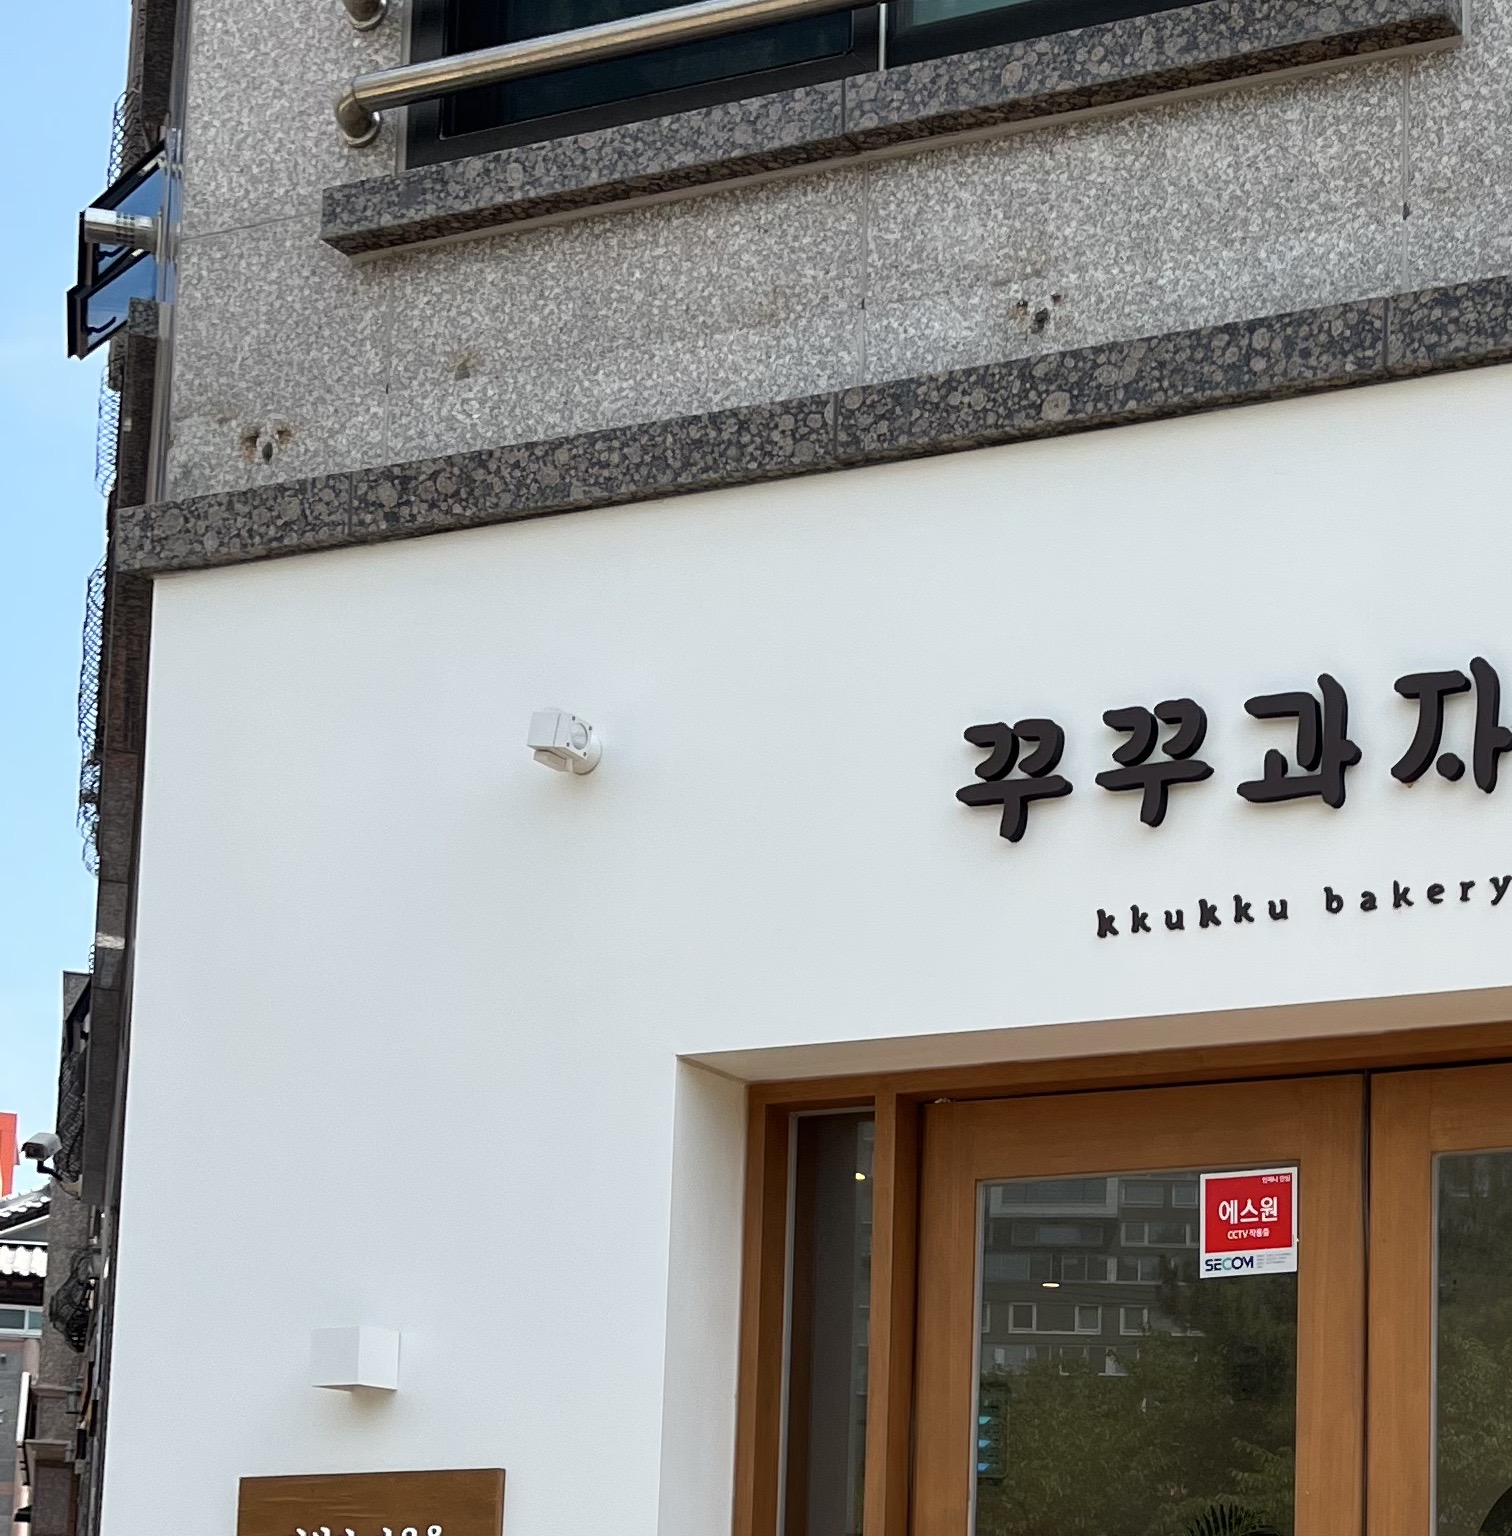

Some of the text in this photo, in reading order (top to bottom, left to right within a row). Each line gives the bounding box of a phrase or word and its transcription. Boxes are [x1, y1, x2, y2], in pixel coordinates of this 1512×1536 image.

[1096, 875, 1512, 939] kkukku bakery
[1218, 1196, 1278, 1225] 에스원
[1227, 1229, 1249, 1240] CCTV
[1205, 1255, 1254, 1272] SECOM
